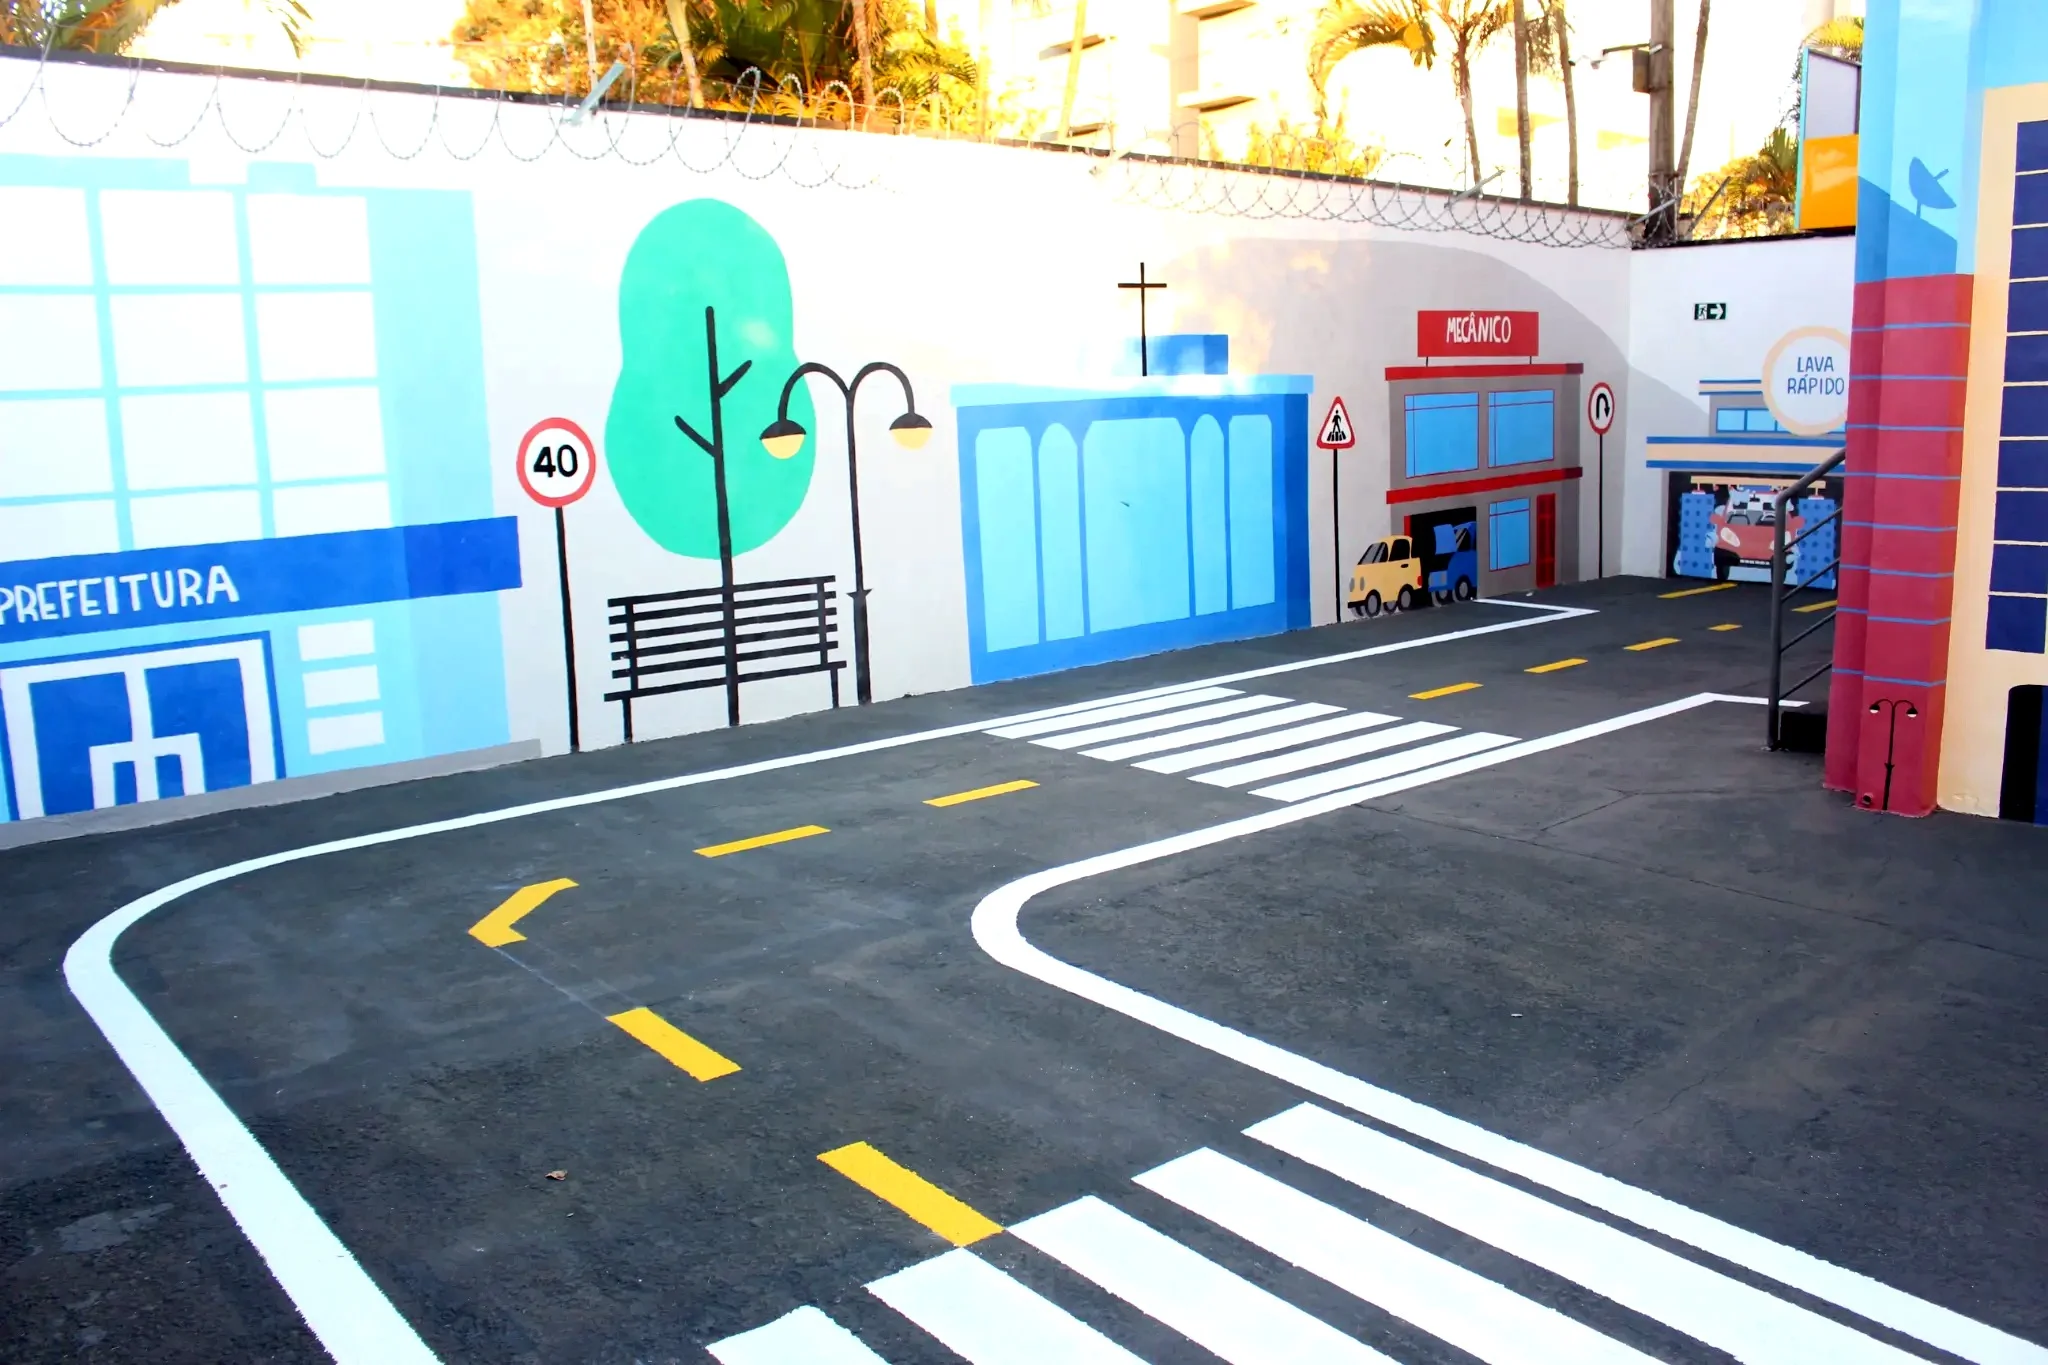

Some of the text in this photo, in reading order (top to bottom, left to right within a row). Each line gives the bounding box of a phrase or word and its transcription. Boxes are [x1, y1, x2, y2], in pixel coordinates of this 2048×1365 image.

[1446, 312, 1512, 343] MECÂNICO
[1797, 356, 1835, 372] LAVA
[1787, 374, 1845, 395] RÁPIDO
[533, 444, 578, 478] 40
[0, 565, 240, 625] PREFEITURA
